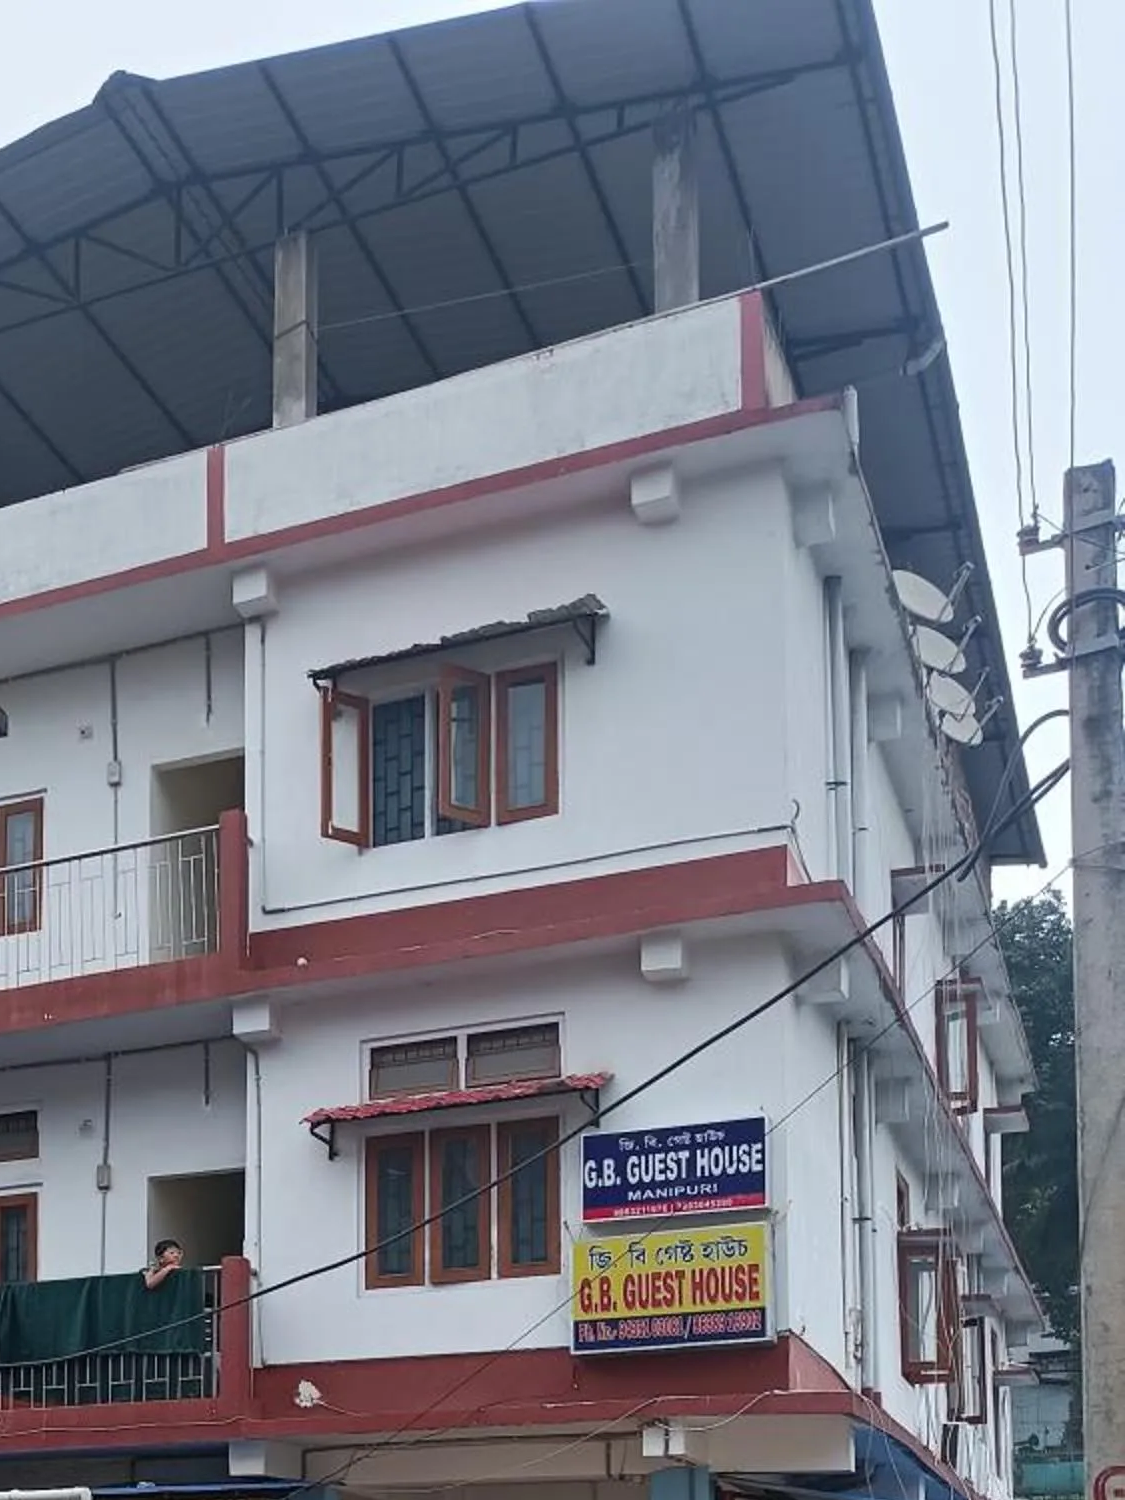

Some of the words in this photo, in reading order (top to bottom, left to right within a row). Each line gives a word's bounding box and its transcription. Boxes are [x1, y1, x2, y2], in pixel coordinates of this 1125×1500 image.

[584, 1158, 621, 1189] G.B.
[626, 1150, 689, 1184] GUEST
[696, 1142, 763, 1177] HOUSE
[627, 1183, 718, 1201] MANIPURI
[579, 1274, 618, 1315] G.B.
[622, 1268, 686, 1312] GUEST
[691, 1262, 760, 1306] HOUSE
